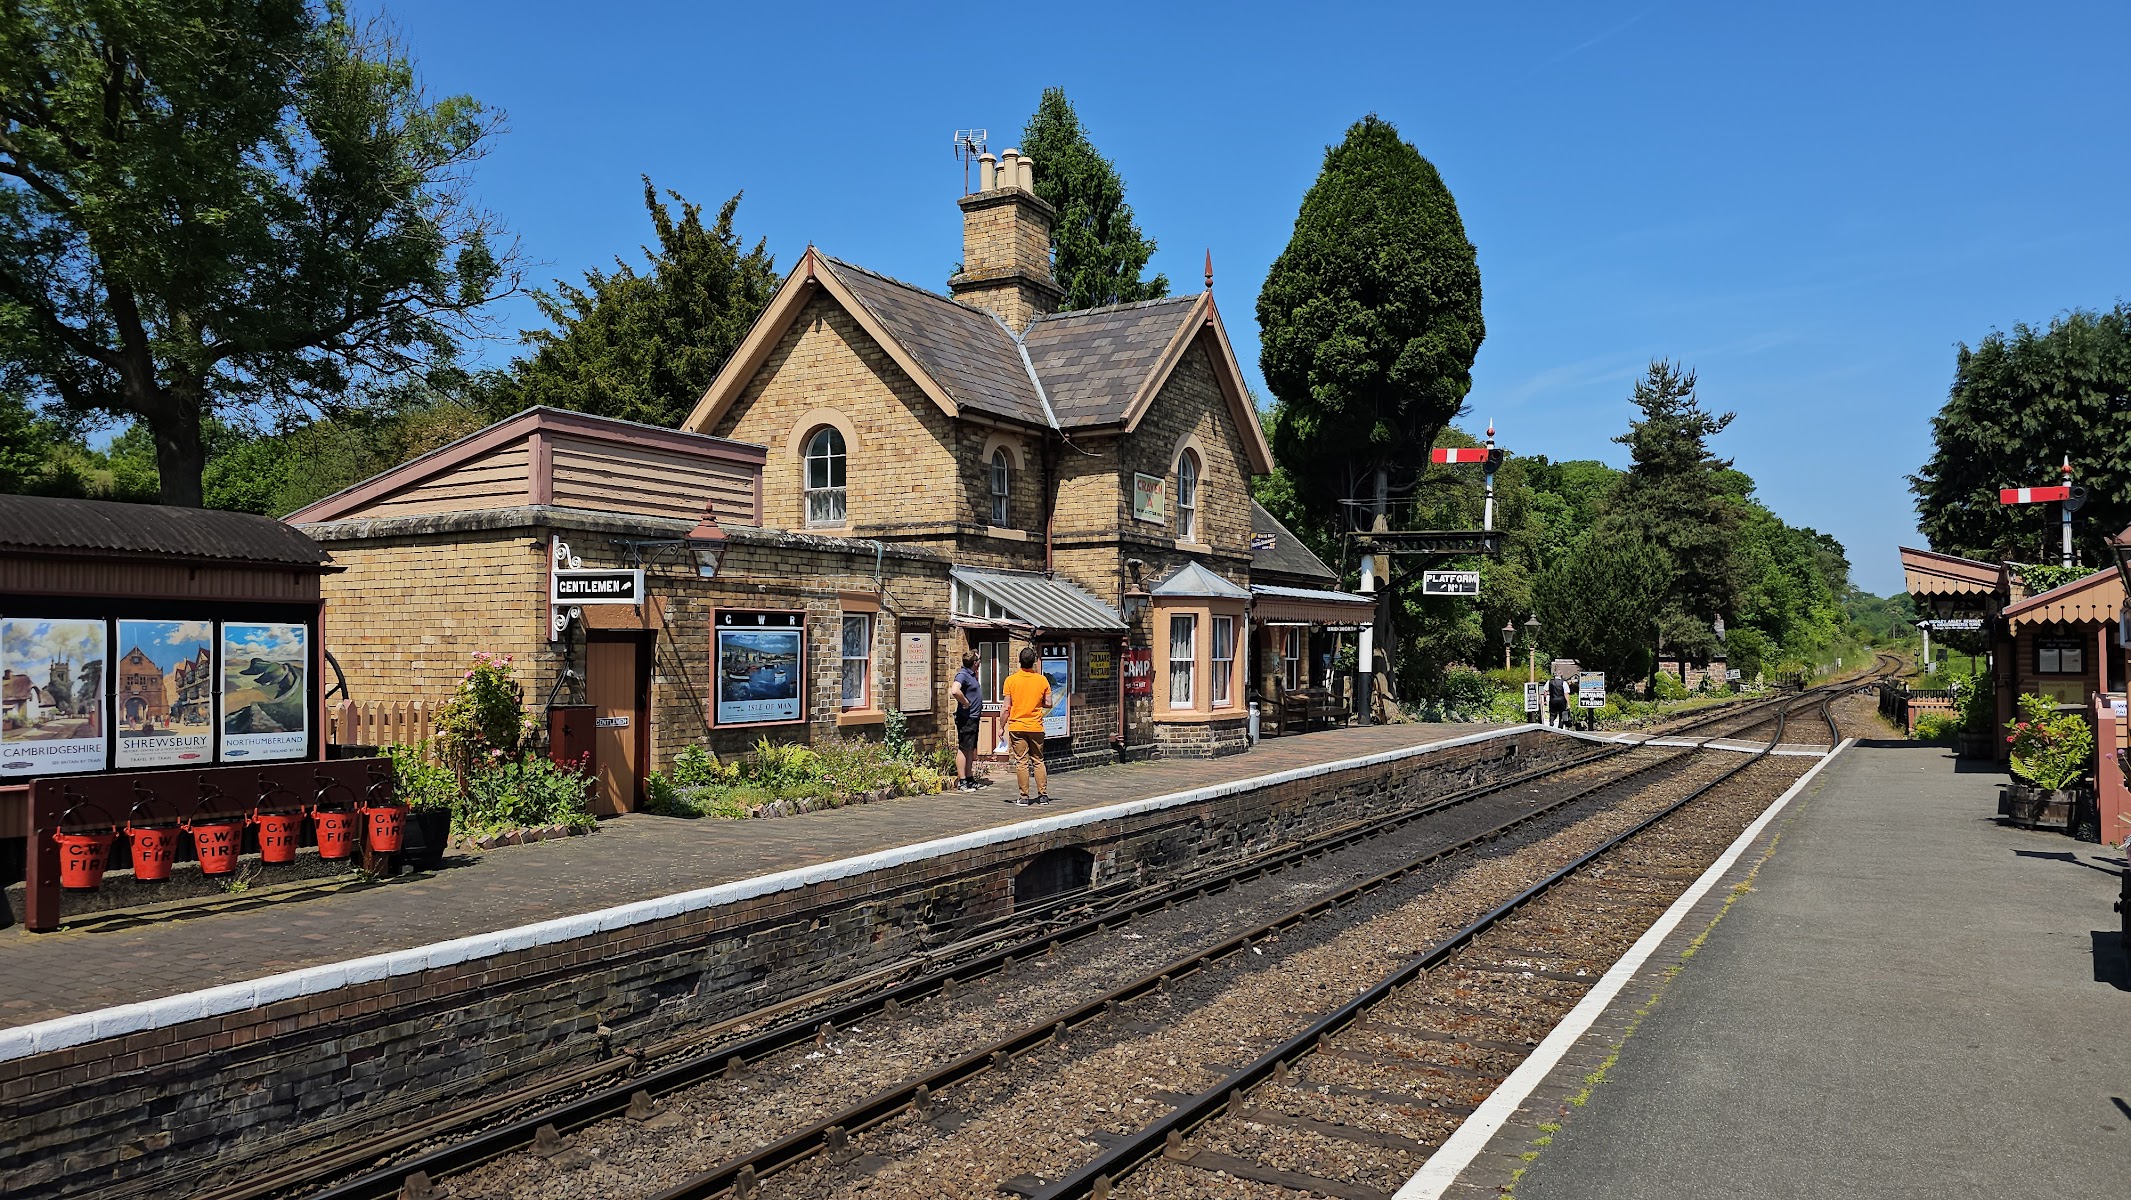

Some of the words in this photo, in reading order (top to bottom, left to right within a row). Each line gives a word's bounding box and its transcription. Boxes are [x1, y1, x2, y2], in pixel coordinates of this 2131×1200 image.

[1137, 479, 1162, 496] CRAVEN
[1426, 574, 1476, 583] PLATFORM
[559, 580, 620, 593] GENTLEMEN
[1124, 660, 1150, 677] CAMP
[124, 736, 207, 749] SHREWSBURY
[226, 737, 302, 746] NORTHUMBERLAND
[3, 744, 101, 757] CAMBRIDGESHIRE
[376, 826, 404, 836] FIR
[201, 844, 239, 857] FIRE
